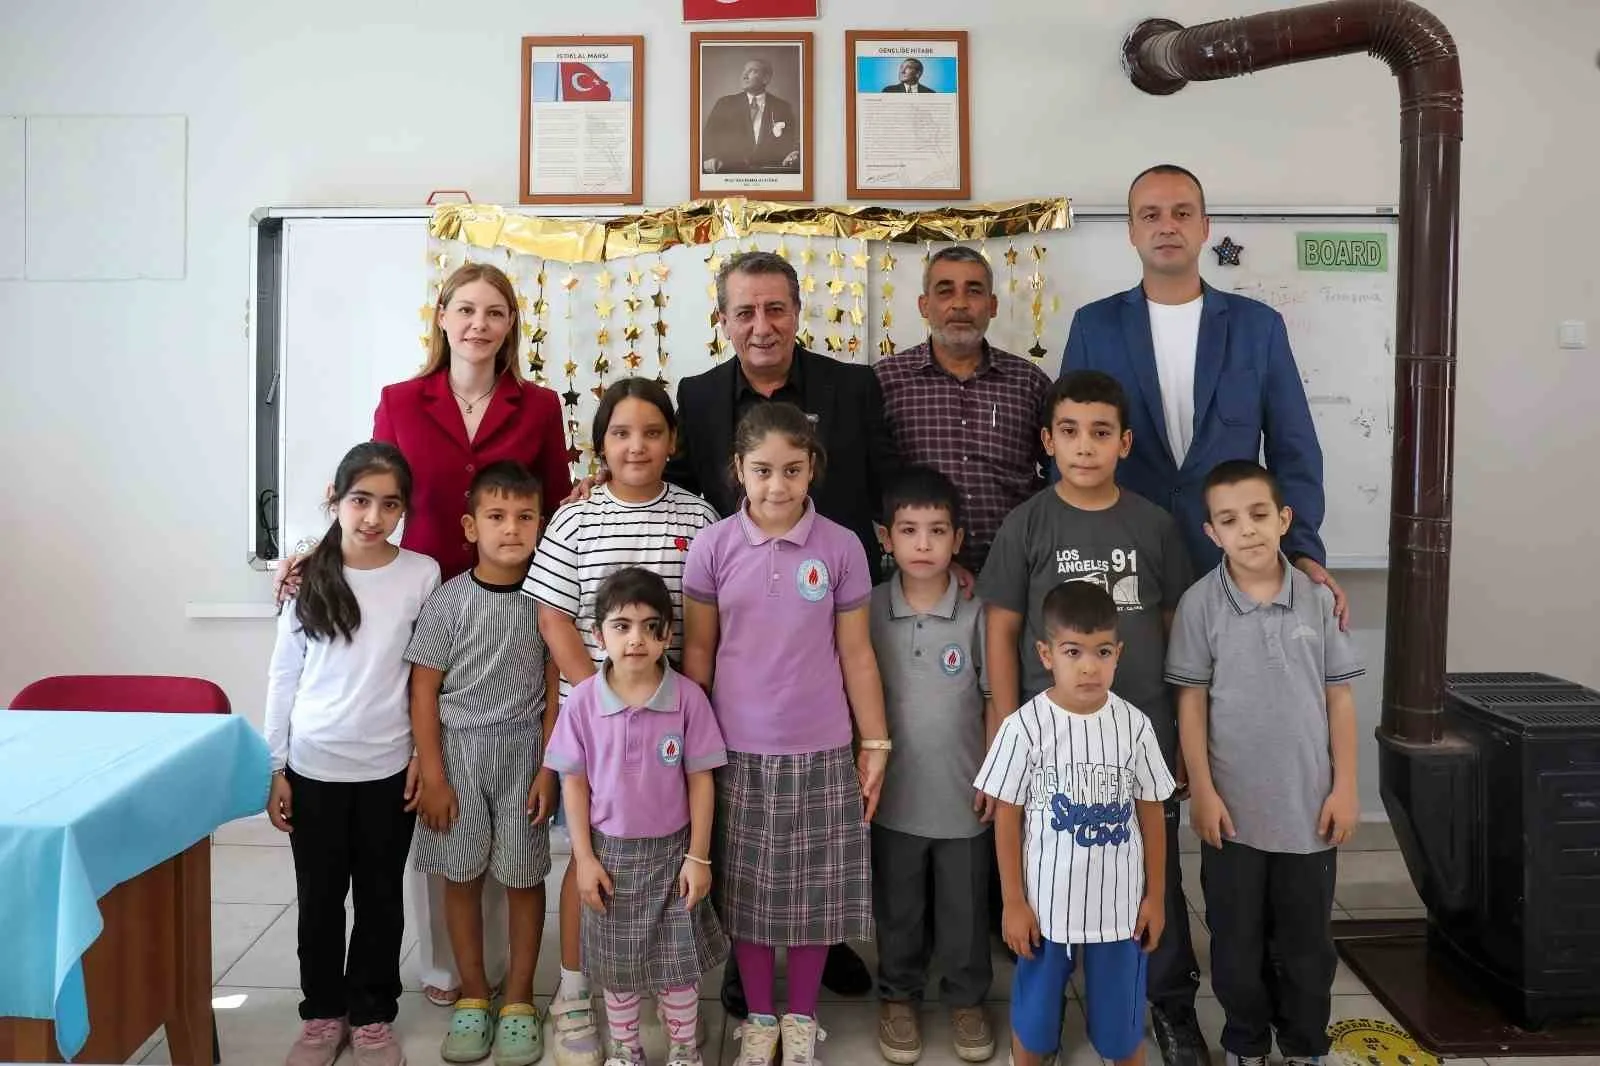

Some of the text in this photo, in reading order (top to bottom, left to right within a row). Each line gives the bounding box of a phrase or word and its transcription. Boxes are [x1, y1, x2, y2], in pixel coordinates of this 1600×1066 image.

[1305, 239, 1382, 266] BOARD
[1056, 549, 1080, 561] LOS
[1057, 560, 1110, 573] ANGELES
[1112, 548, 1137, 573] 91
[1027, 766, 1057, 812] OS
